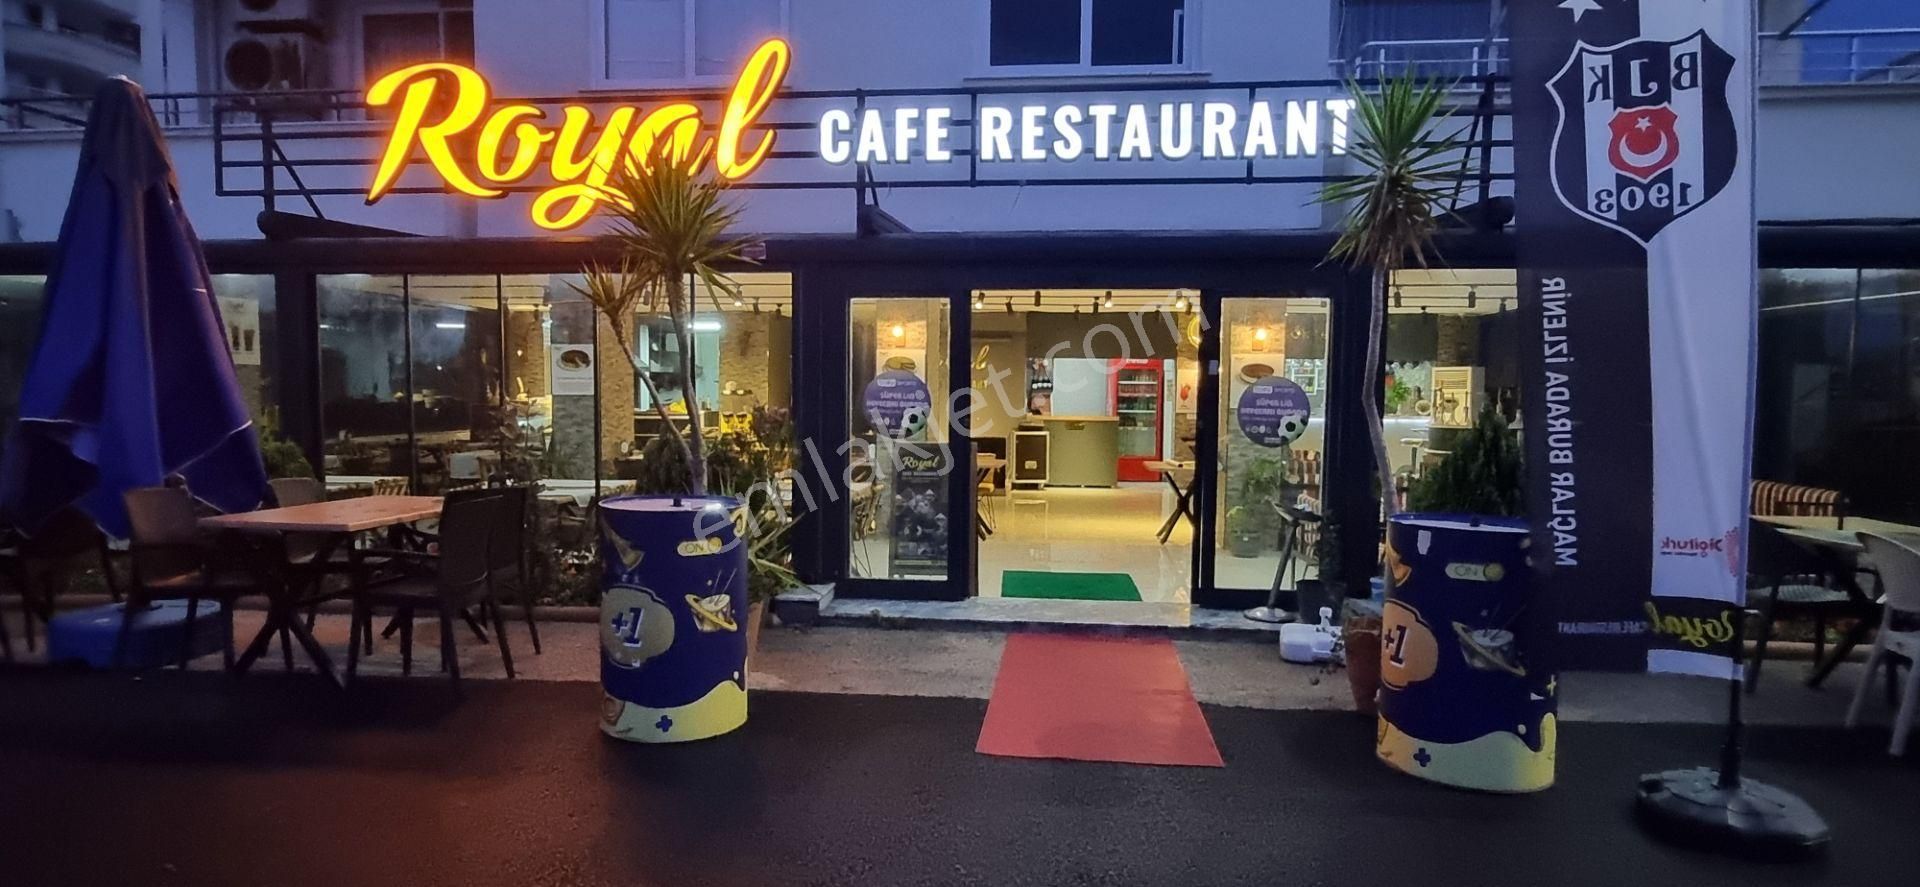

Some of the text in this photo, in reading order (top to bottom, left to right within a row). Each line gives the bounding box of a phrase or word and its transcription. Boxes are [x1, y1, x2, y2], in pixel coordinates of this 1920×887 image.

[365, 37, 1356, 230] Royal CAFE RESTAURANT
[902, 456, 940, 471] Royal
[685, 542, 704, 553] ON
[1453, 565, 1478, 577] ON
[611, 607, 644, 647] +1
[1384, 624, 1408, 668] +1
